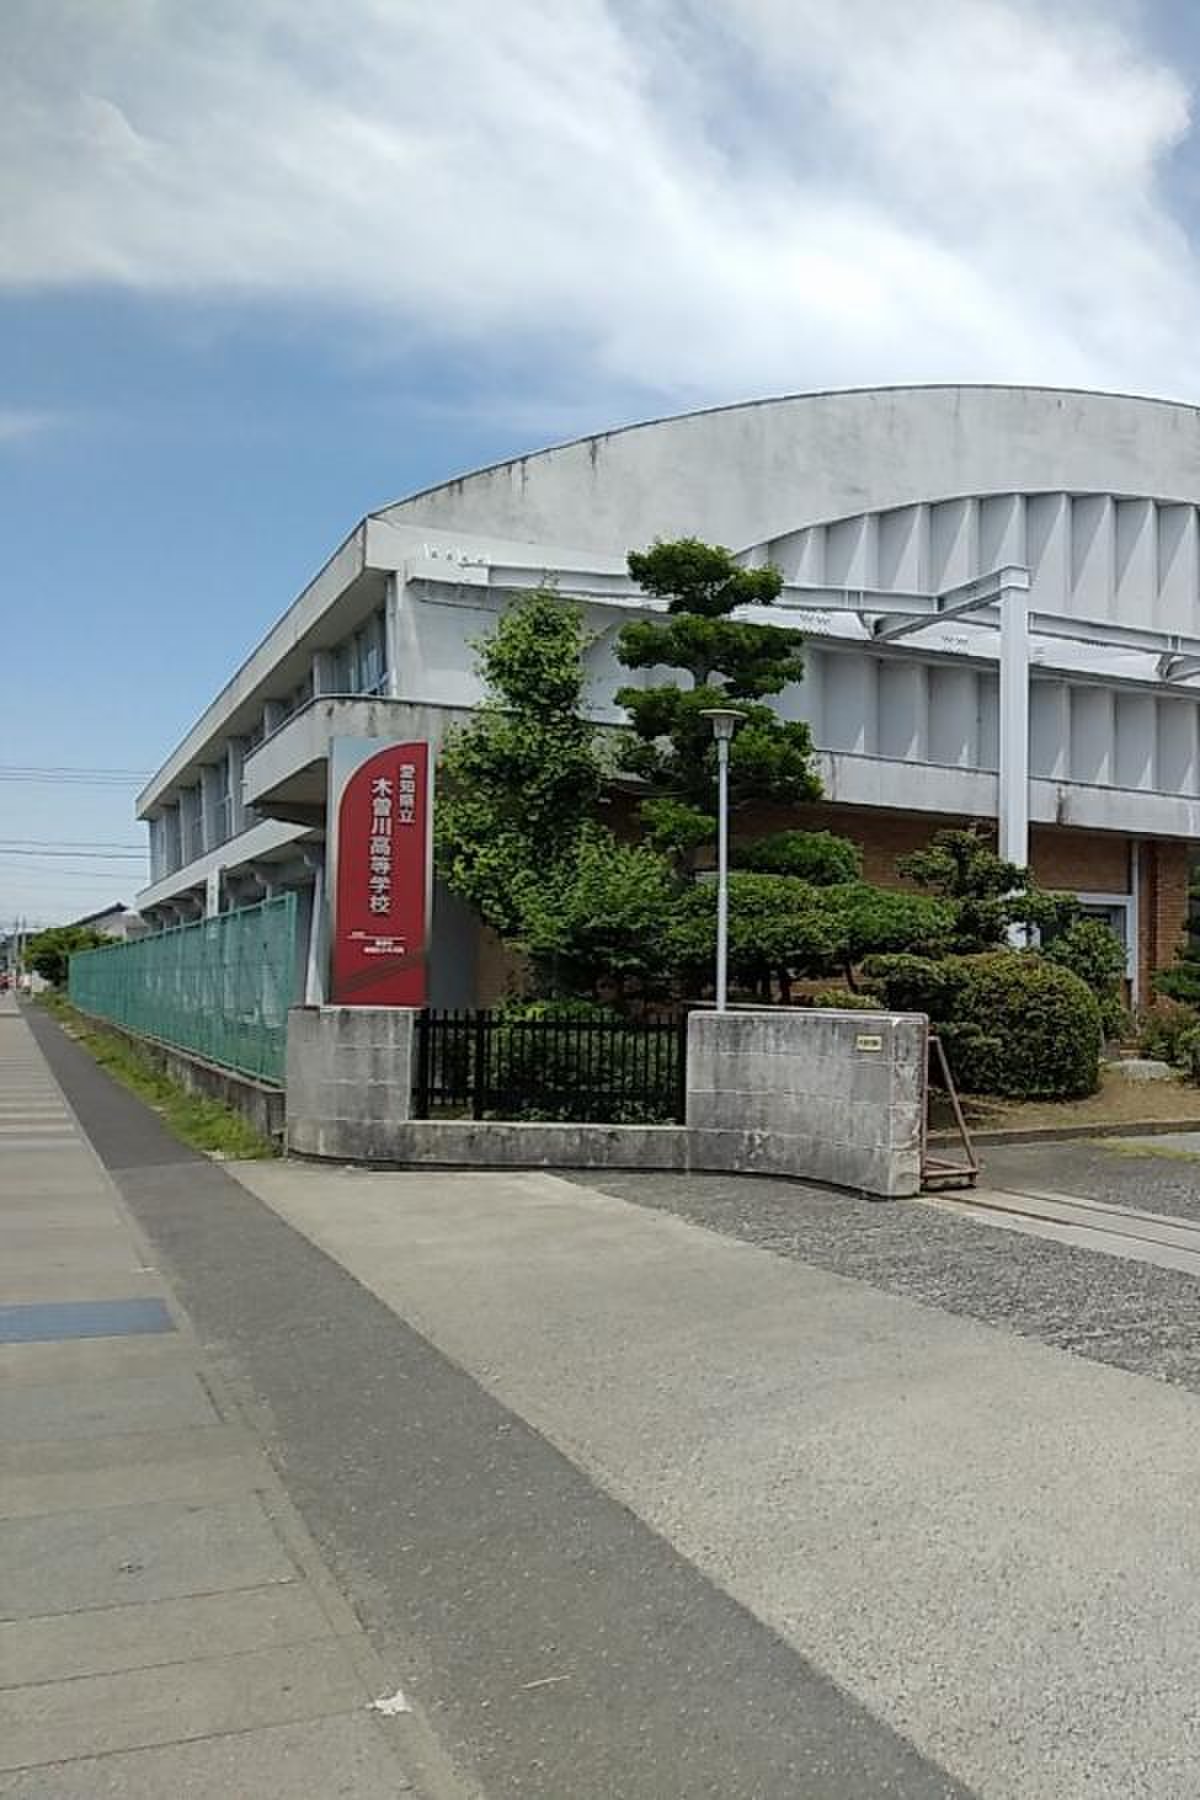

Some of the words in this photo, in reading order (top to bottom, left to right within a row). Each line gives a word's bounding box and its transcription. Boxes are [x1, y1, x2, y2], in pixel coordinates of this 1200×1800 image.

[368, 777, 394, 914] 木曽川高等学校
